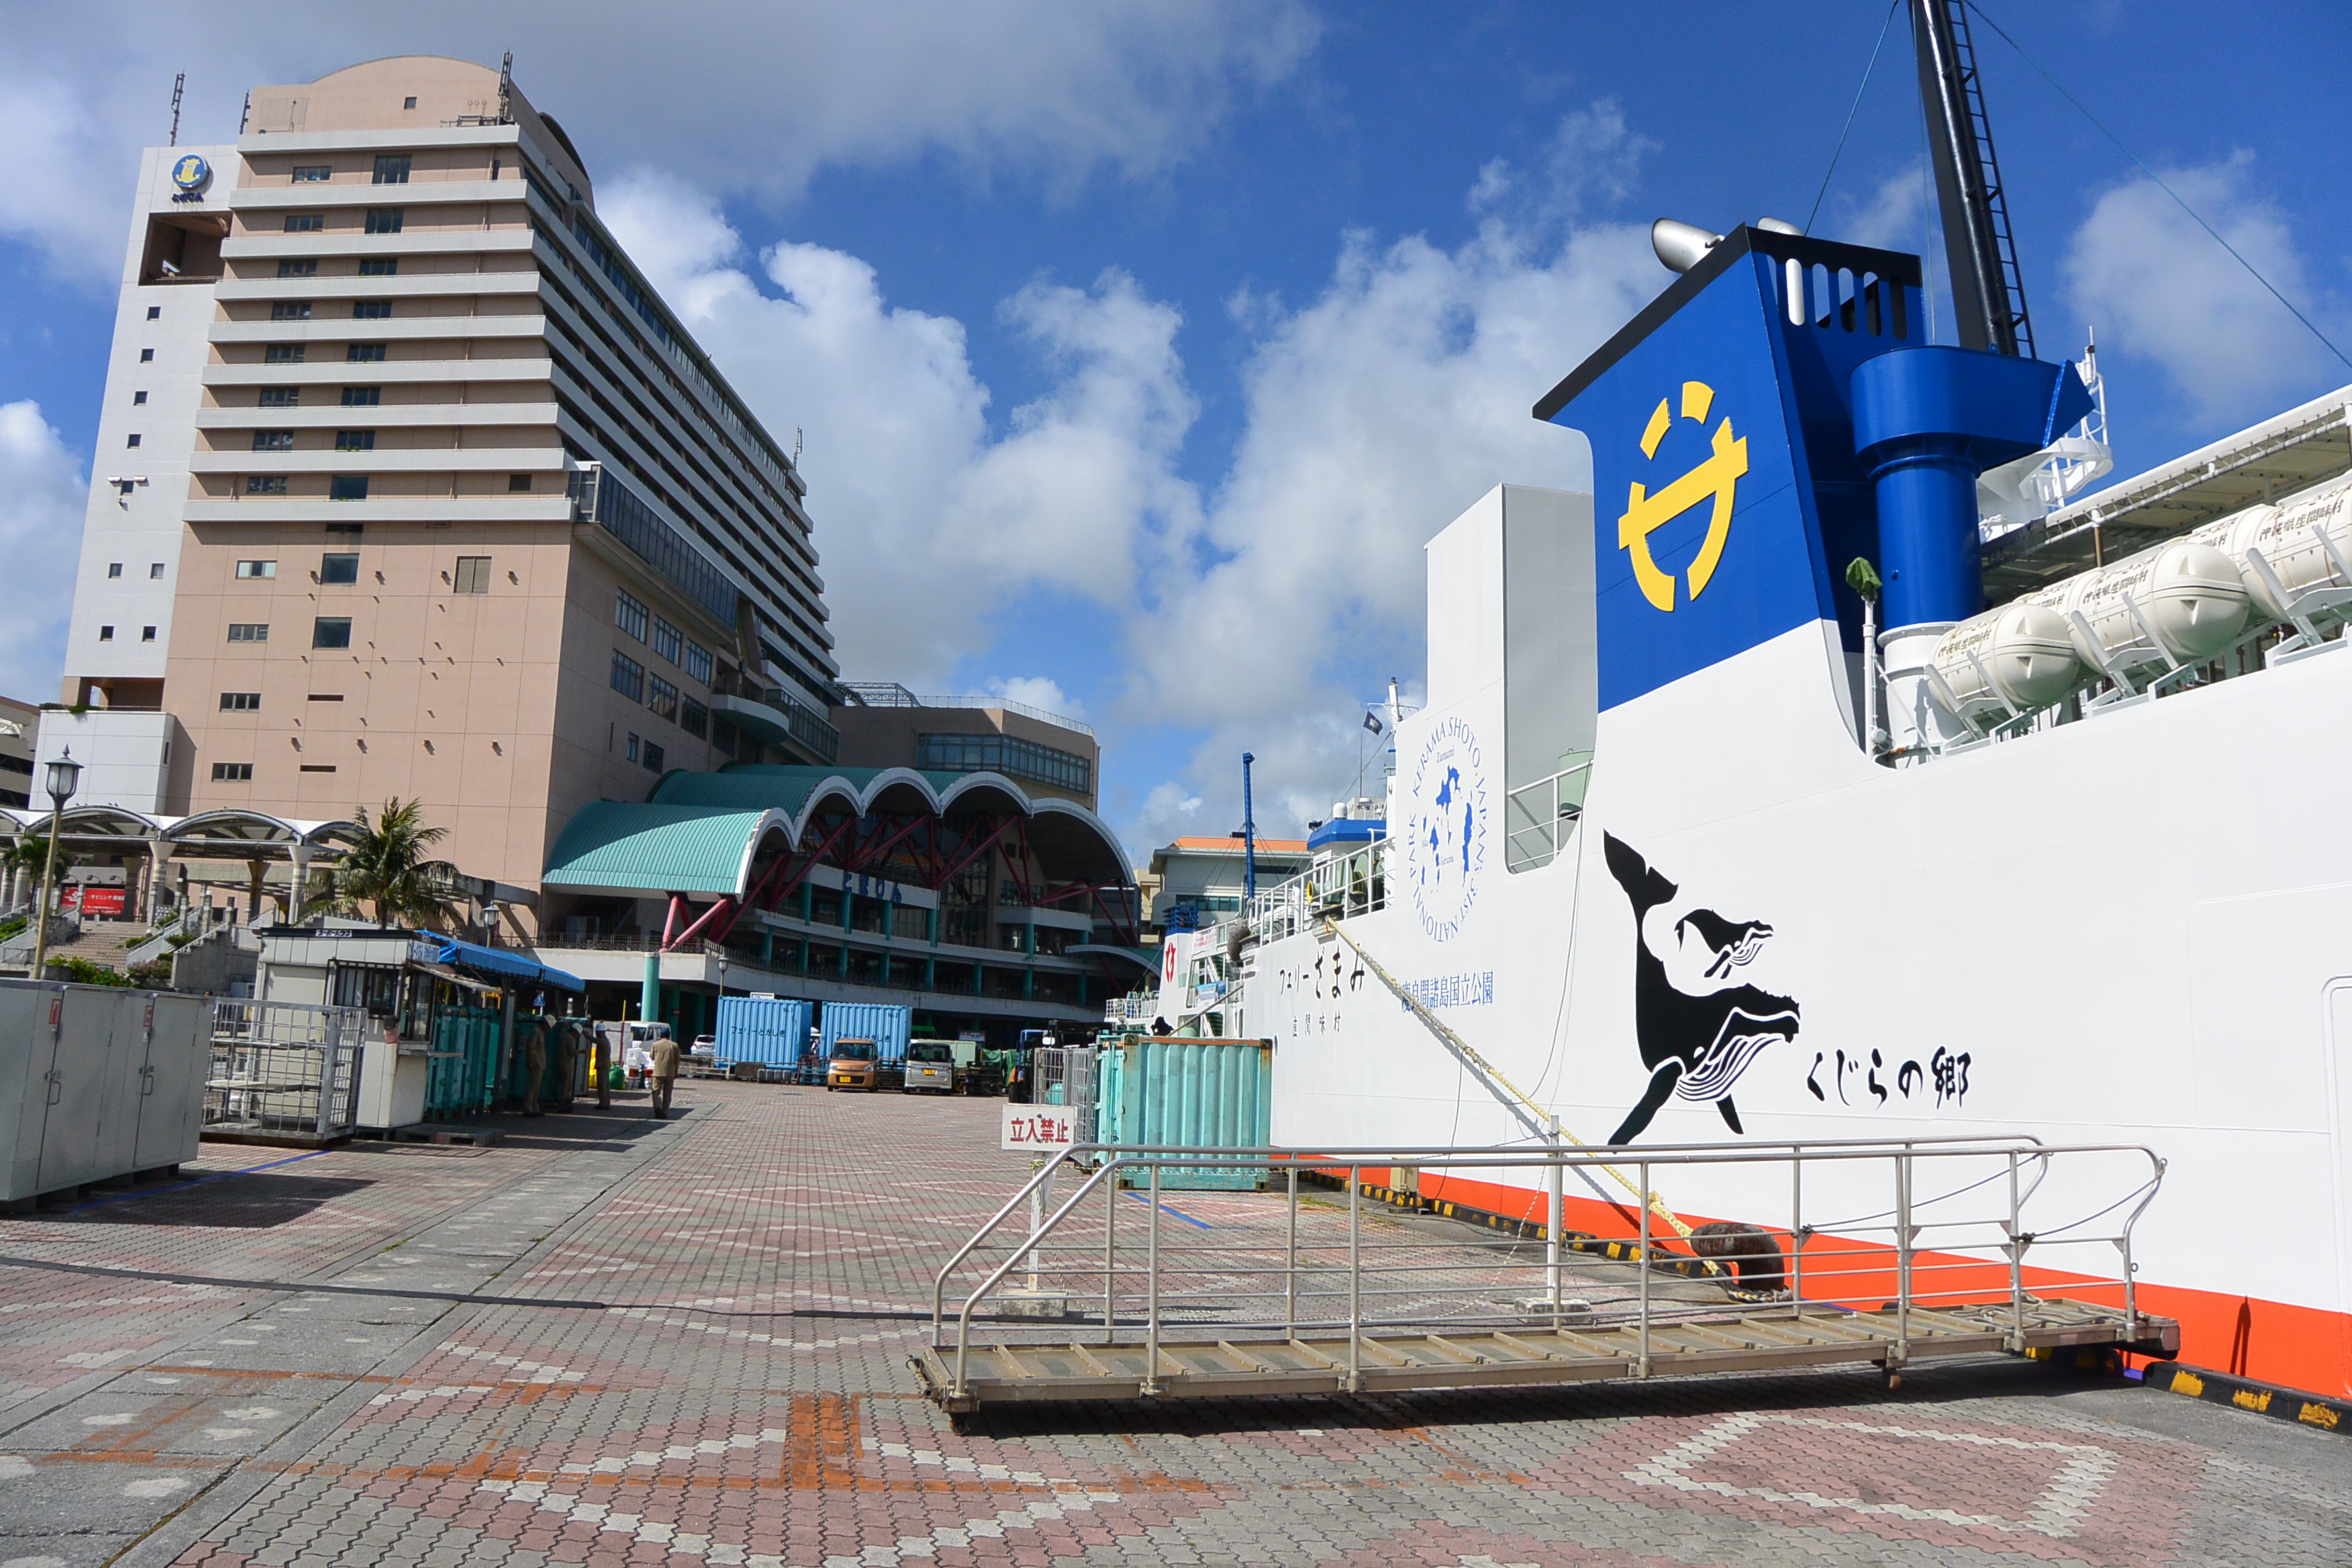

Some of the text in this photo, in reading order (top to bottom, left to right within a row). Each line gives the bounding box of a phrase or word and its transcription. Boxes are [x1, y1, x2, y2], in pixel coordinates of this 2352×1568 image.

[172, 193, 205, 203] とまりん
[2259, 499, 2344, 542] 沖縄県座間味村
[1413, 721, 1446, 797] KERAMA
[1437, 745, 1454, 764] Zamami
[843, 872, 902, 903] とまりん
[1413, 881, 1458, 942] NATIONAL
[1279, 942, 1365, 1000] フェリーざまみ
[732, 1026, 785, 1037] フェリーとかしき
[1293, 1010, 1341, 1038] 座間味村
[1807, 1046, 1971, 1110] くじらの郷
[1010, 1117, 1069, 1144] 立入禁止
